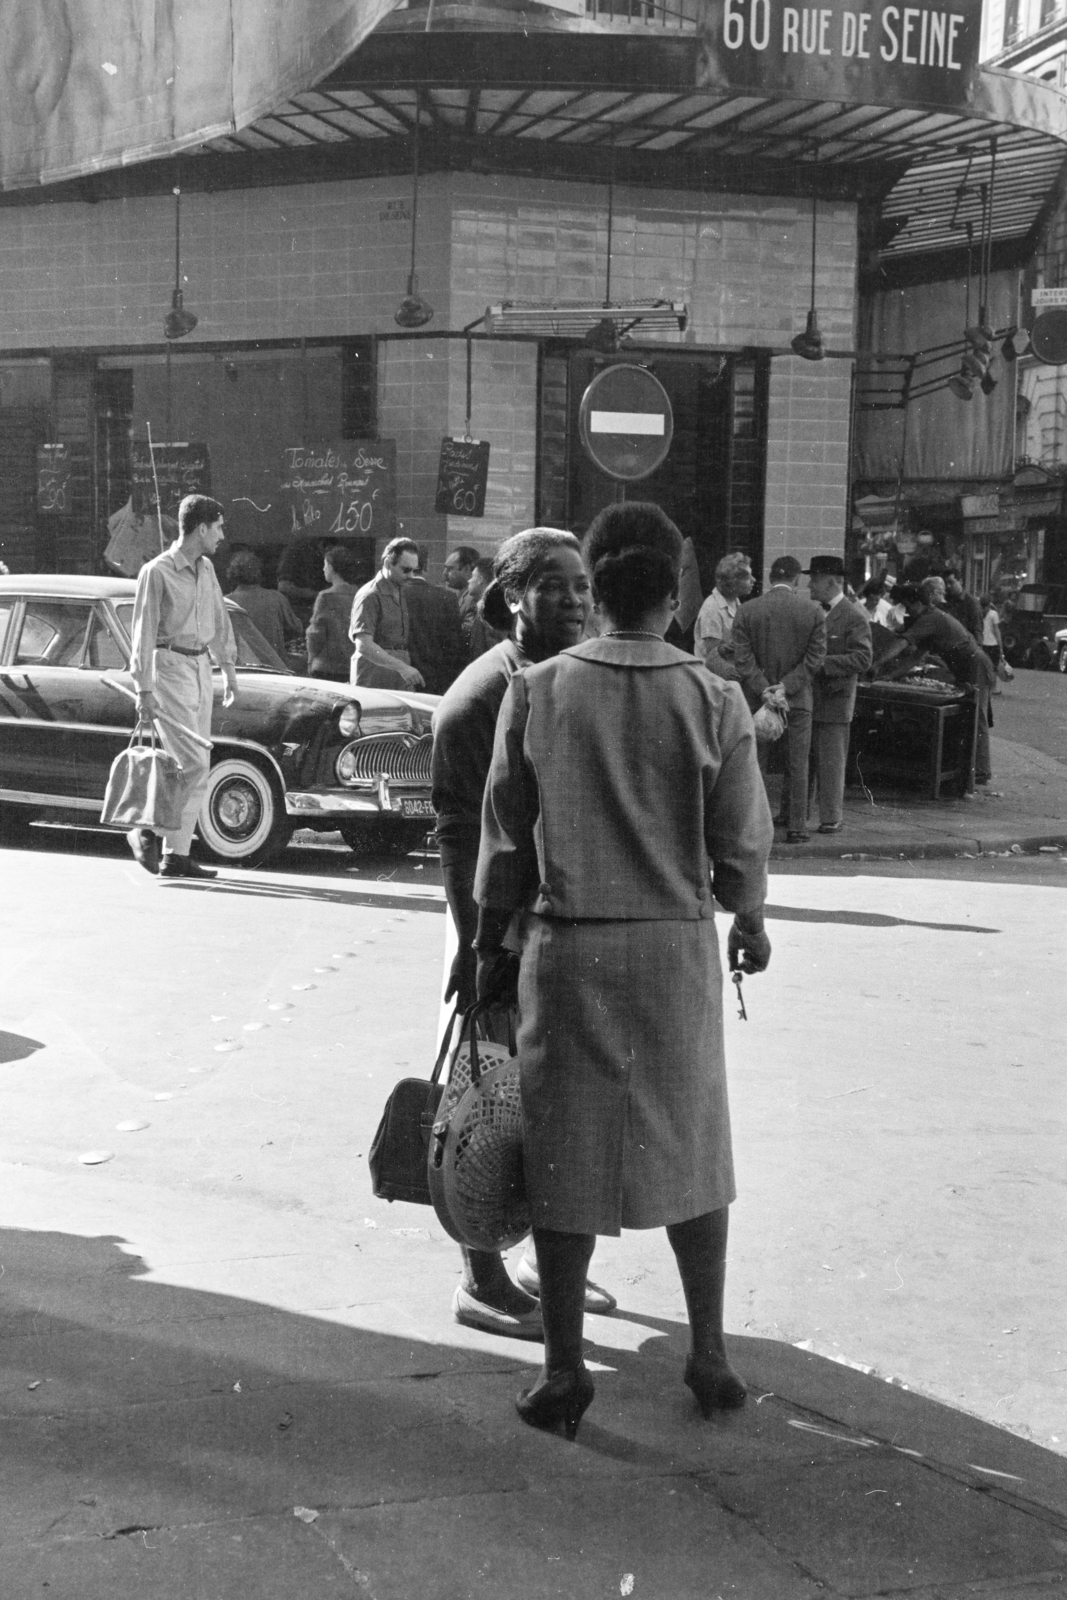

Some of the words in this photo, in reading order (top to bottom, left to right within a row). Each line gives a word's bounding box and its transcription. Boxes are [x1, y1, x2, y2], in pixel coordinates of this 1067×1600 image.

[723, 0, 770, 50] 60
[782, 7, 832, 55] RUE
[842, 11, 872, 59] DE
[880, 6, 965, 70] SEINE
[285, 448, 340, 468] Tomates
[42, 487, 66, 510] 90
[453, 488, 476, 512] 60
[329, 500, 374, 533] 150
